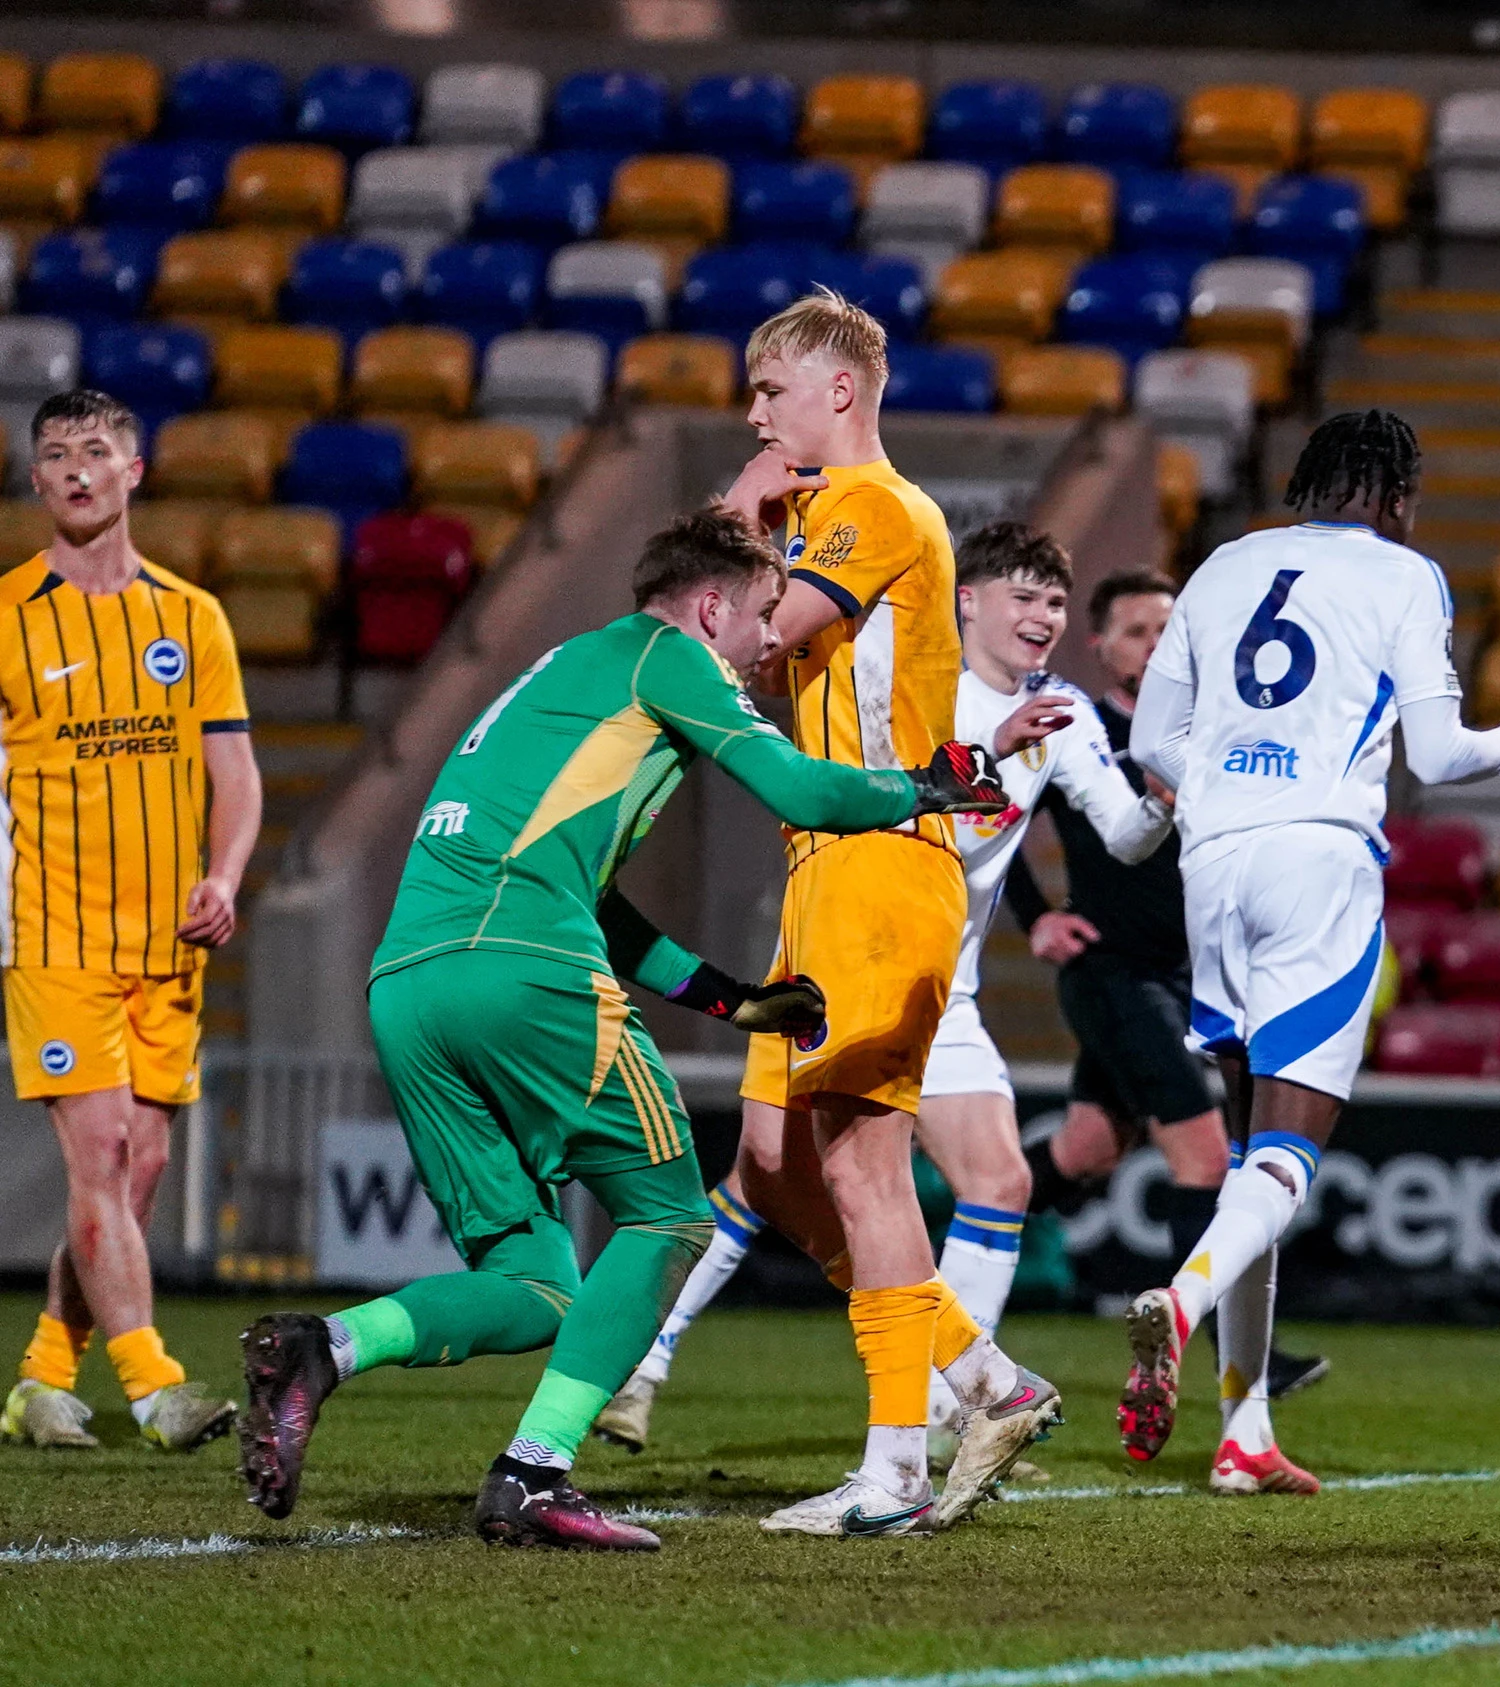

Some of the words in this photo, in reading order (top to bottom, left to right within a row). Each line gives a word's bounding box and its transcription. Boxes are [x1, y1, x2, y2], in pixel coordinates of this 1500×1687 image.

[1234, 569, 1317, 710] 6
[1223, 742, 1300, 779] amt
[413, 801, 471, 842] mt
[329, 1158, 448, 1242] W
